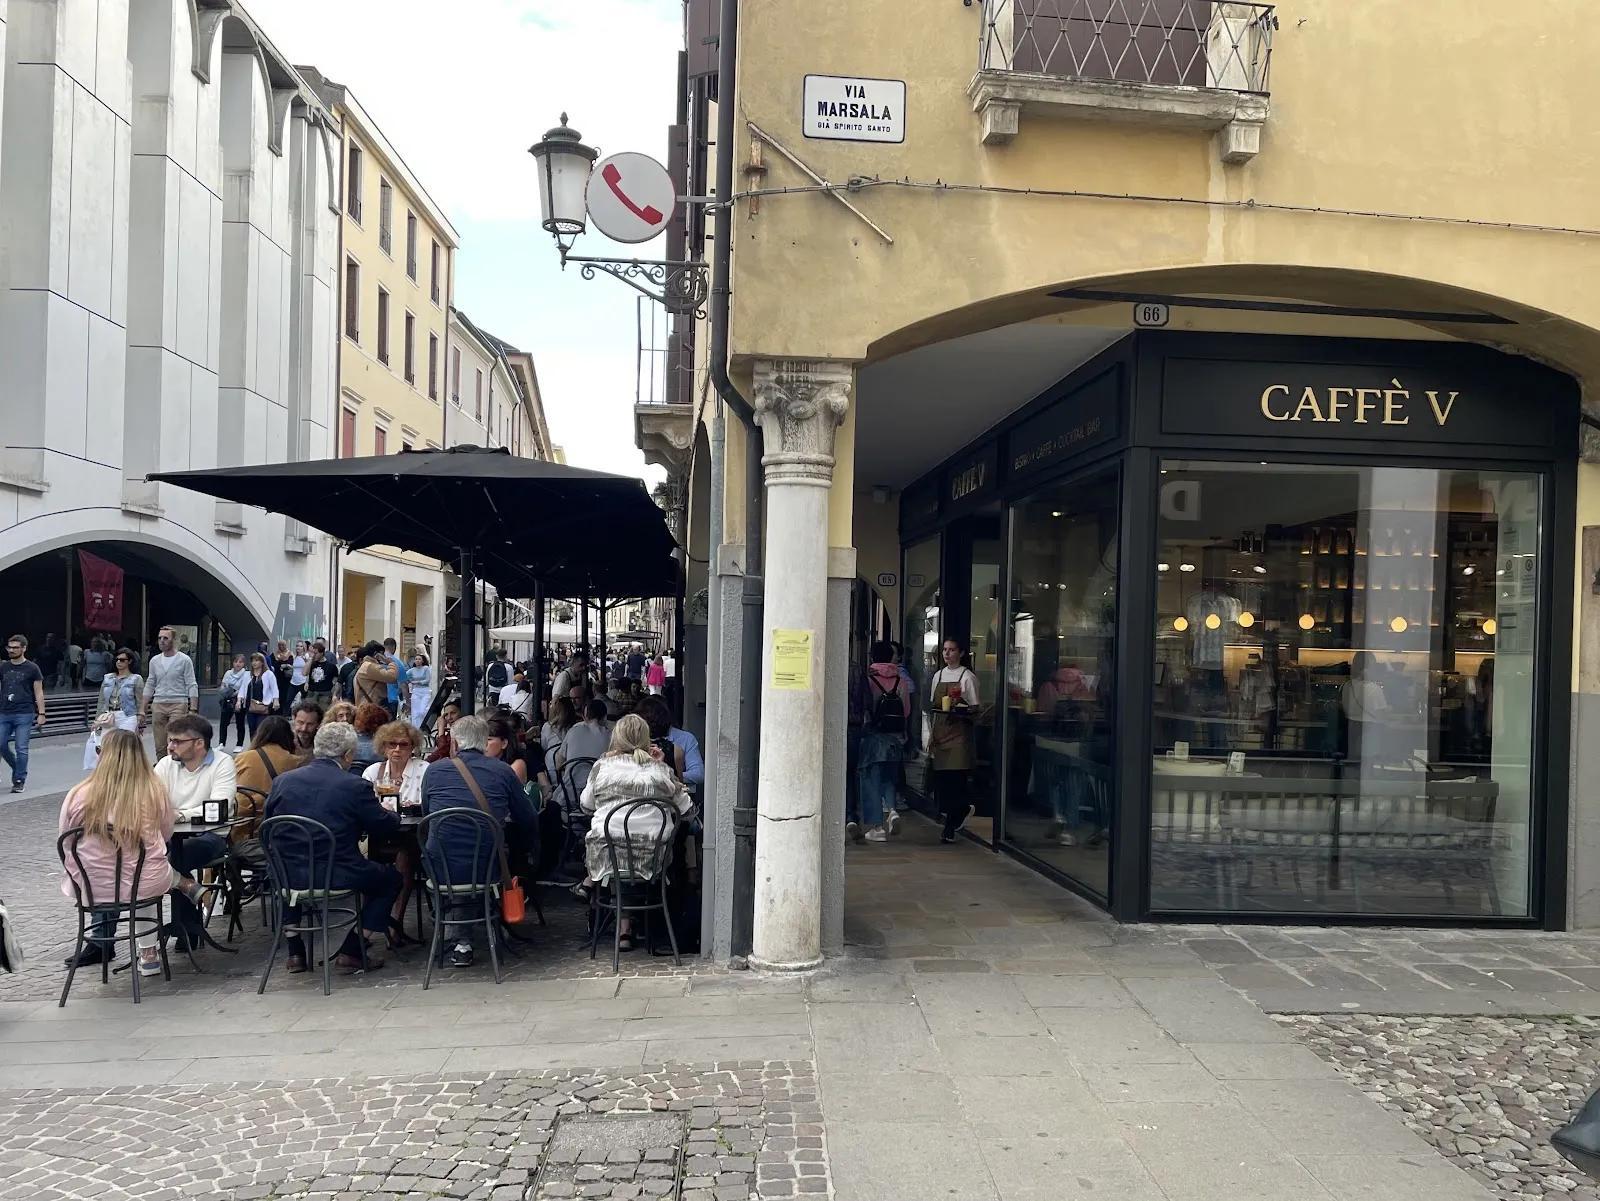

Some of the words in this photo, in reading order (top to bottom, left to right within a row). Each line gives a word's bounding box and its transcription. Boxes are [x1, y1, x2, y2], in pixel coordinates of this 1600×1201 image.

[845, 85, 866, 98] VIA
[817, 101, 892, 120] MARSALA
[817, 118, 830, 129] GIÀ
[834, 122, 863, 131] SPIRITO
[867, 124, 891, 133] SANTO
[1143, 306, 1160, 322] 66
[1260, 377, 1411, 425] CAFFÈ
[1425, 390, 1460, 426] V
[1086, 416, 1101, 436] BAR
